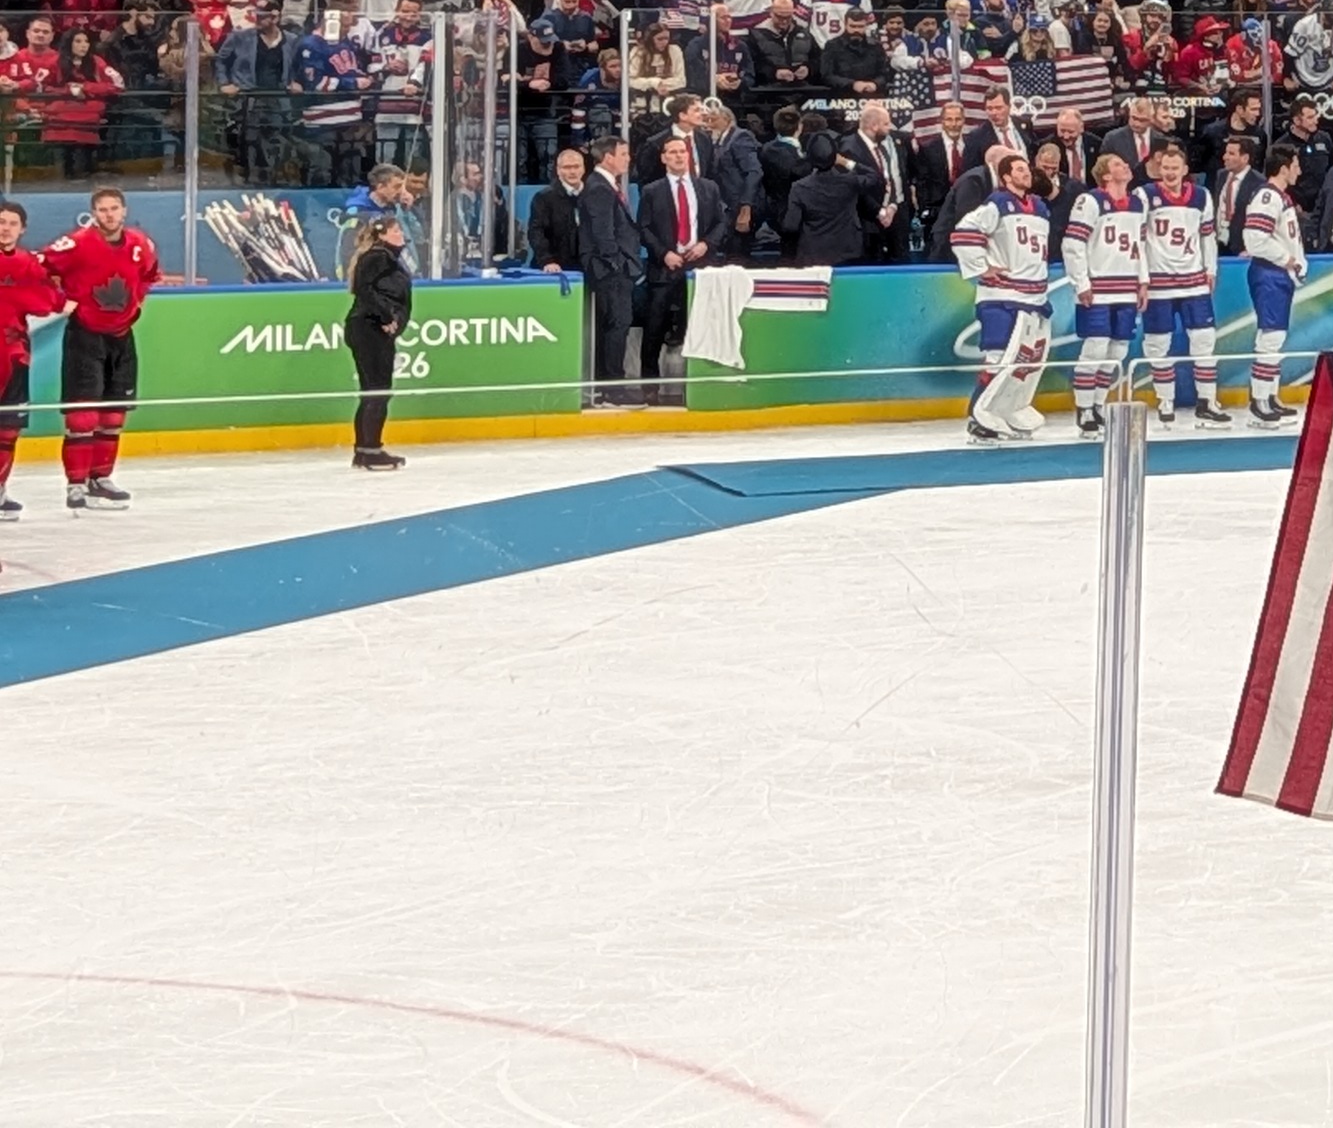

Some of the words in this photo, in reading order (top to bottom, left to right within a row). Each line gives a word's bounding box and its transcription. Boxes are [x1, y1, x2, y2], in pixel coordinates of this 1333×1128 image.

[815, 10, 841, 34] US
[801, 99, 857, 110] MILANO
[858, 98, 914, 110] CTINA
[1104, 225, 1141, 260] USA
[1155, 218, 1195, 255] USA
[132, 246, 142, 262] C
[220, 323, 346, 354] MILAN
[396, 316, 558, 347] CORTINA
